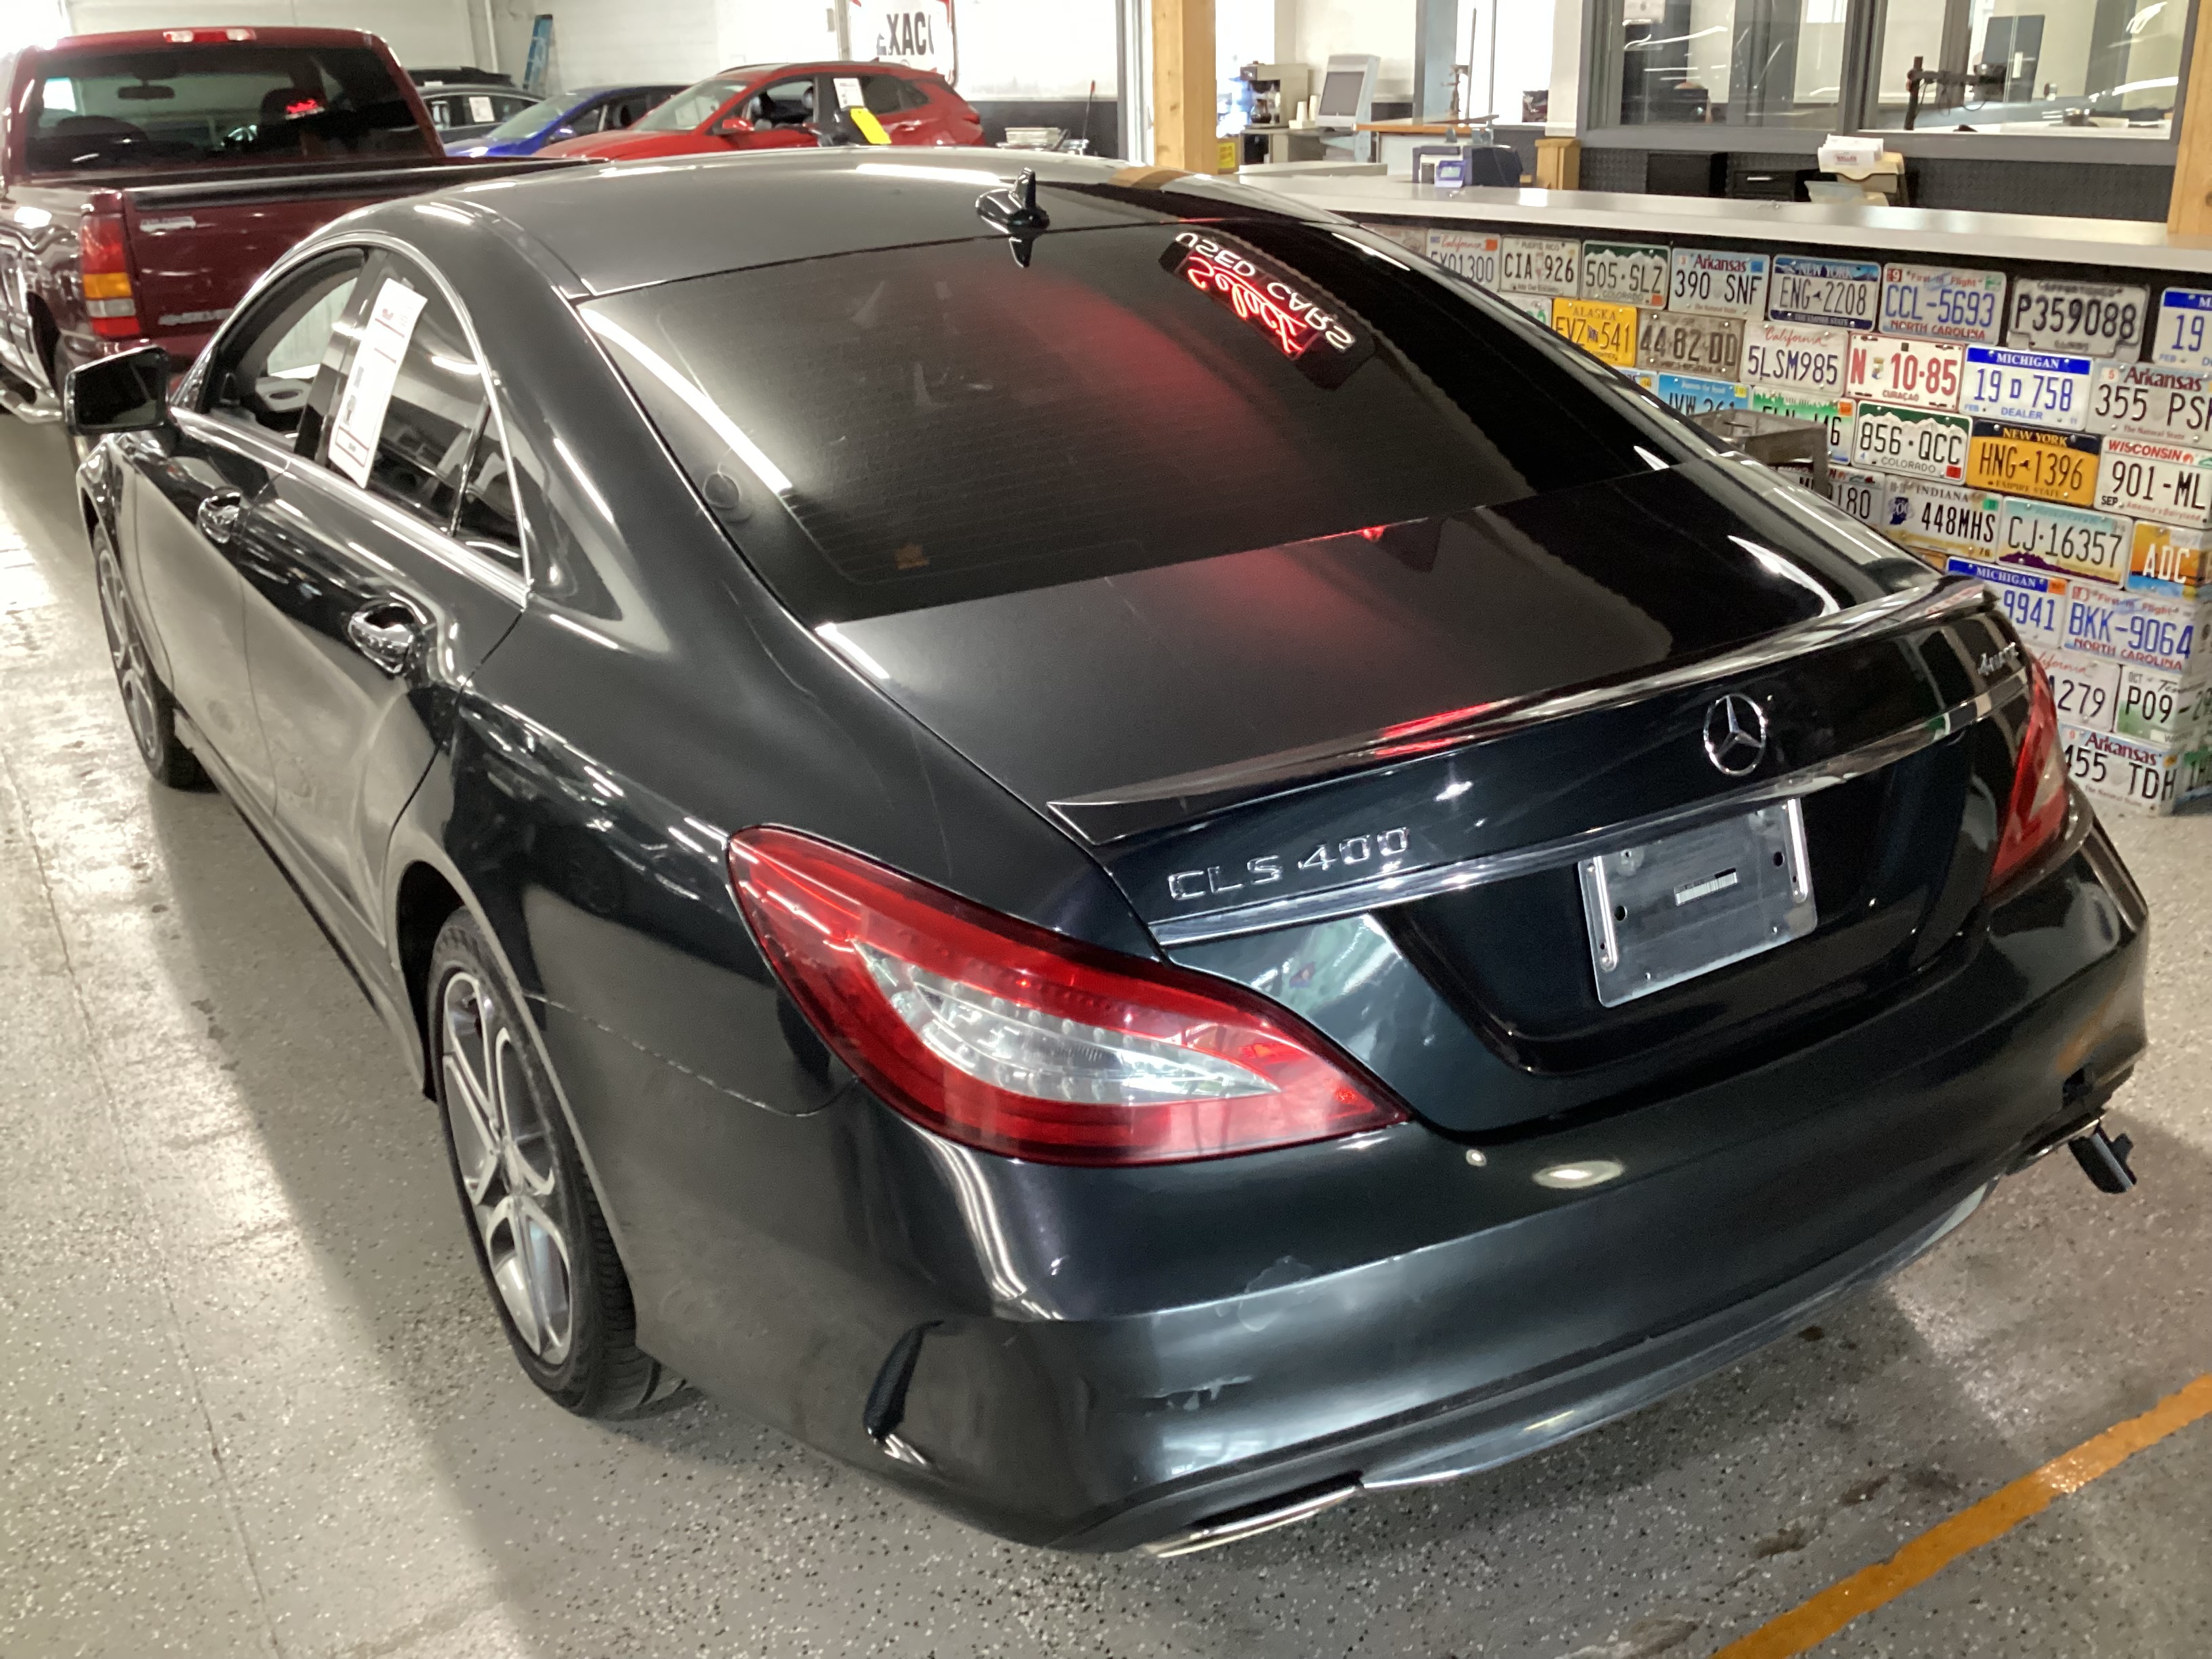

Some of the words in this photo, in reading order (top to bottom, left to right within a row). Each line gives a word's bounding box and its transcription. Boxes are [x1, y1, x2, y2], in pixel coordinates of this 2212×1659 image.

[1504, 253, 1532, 279] CIA
[1544, 255, 1574, 283] 926
[1694, 253, 1746, 272] Arkansas
[1799, 263, 1822, 276] NEW
[1824, 265, 1853, 279] YORK
[1602, 291, 1643, 302] COLORADO
[1675, 269, 1710, 300] 390
[1724, 274, 1762, 304] SNF
[1780, 276, 1811, 310] ENG
[1823, 281, 1867, 316] 2208
[1572, 306, 1616, 321] ALASKA
[1885, 284, 1995, 328] CCL-5693
[2015, 293, 2136, 340] P359088
[1600, 322, 1630, 353] 541
[1764, 325, 1828, 347] California
[1891, 320, 1928, 332] NORTH
[1931, 324, 1985, 341] CAROLINA
[2171, 314, 2205, 352] 19
[1747, 345, 1838, 385] 5LSM985
[1850, 348, 1867, 385] N
[1996, 352, 2060, 369] MICHIGAN
[1973, 367, 2002, 403] 19
[2009, 378, 2022, 398] D
[2032, 374, 2073, 412] 758
[2124, 366, 2202, 392] Arkansas
[1964, 403, 1980, 413] FEB
[2001, 407, 2043, 420] DEALER
[2095, 384, 2149, 422] 355
[2003, 427, 2034, 441] NEW
[2035, 431, 2068, 447] YORK
[2123, 424, 2136, 434] The
[2137, 426, 2165, 437] Natural
[1881, 456, 1936, 473] COLORADO
[2108, 439, 2183, 462] WISCONSIN
[1979, 441, 2018, 479] HNG
[2034, 449, 2083, 491] 1396
[1914, 484, 1969, 503] INDIANA
[1995, 480, 2030, 492] EMPIRE
[2032, 487, 2060, 497] STATE
[2102, 495, 2118, 506] SEP
[1921, 501, 1996, 543] 448MHS
[1975, 566, 2036, 588] MICHIGAN
[2069, 601, 2194, 659] BKK-9064
[2074, 637, 2116, 656] NORTH
[2121, 649, 2182, 671] CAROLINA
[2049, 674, 2106, 718] 279
[2085, 731, 2156, 766] Arkansas
[2129, 761, 2177, 802] TDH
[1168, 855, 1284, 901] CLS
[1297, 826, 1411, 872] 400
